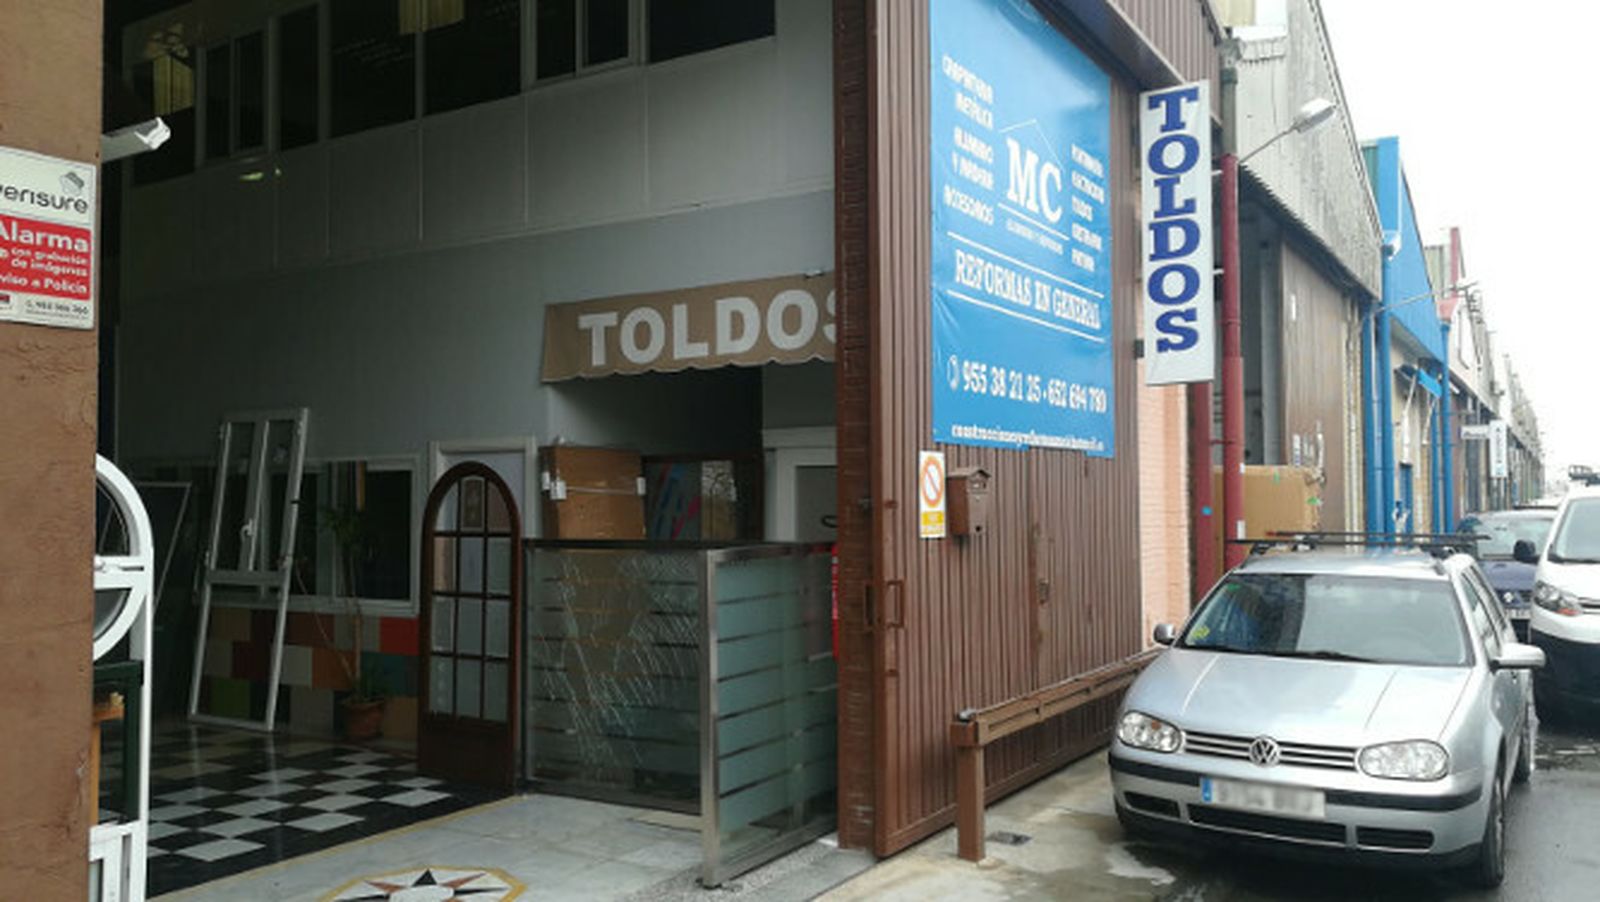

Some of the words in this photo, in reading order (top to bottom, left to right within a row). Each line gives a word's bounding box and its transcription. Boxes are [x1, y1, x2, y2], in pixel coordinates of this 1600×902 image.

[1006, 137, 1063, 223] MC
[1147, 86, 1200, 353] TOLDOS
[955, 248, 1032, 306] REFORMAS
[1034, 281, 1050, 313] EN
[1053, 289, 1101, 330] GENERAL
[962, 360, 987, 395] 955
[990, 366, 1006, 398] 38
[1009, 371, 1023, 401] 21
[1027, 374, 1040, 404] 25
[1047, 379, 1067, 408] 652
